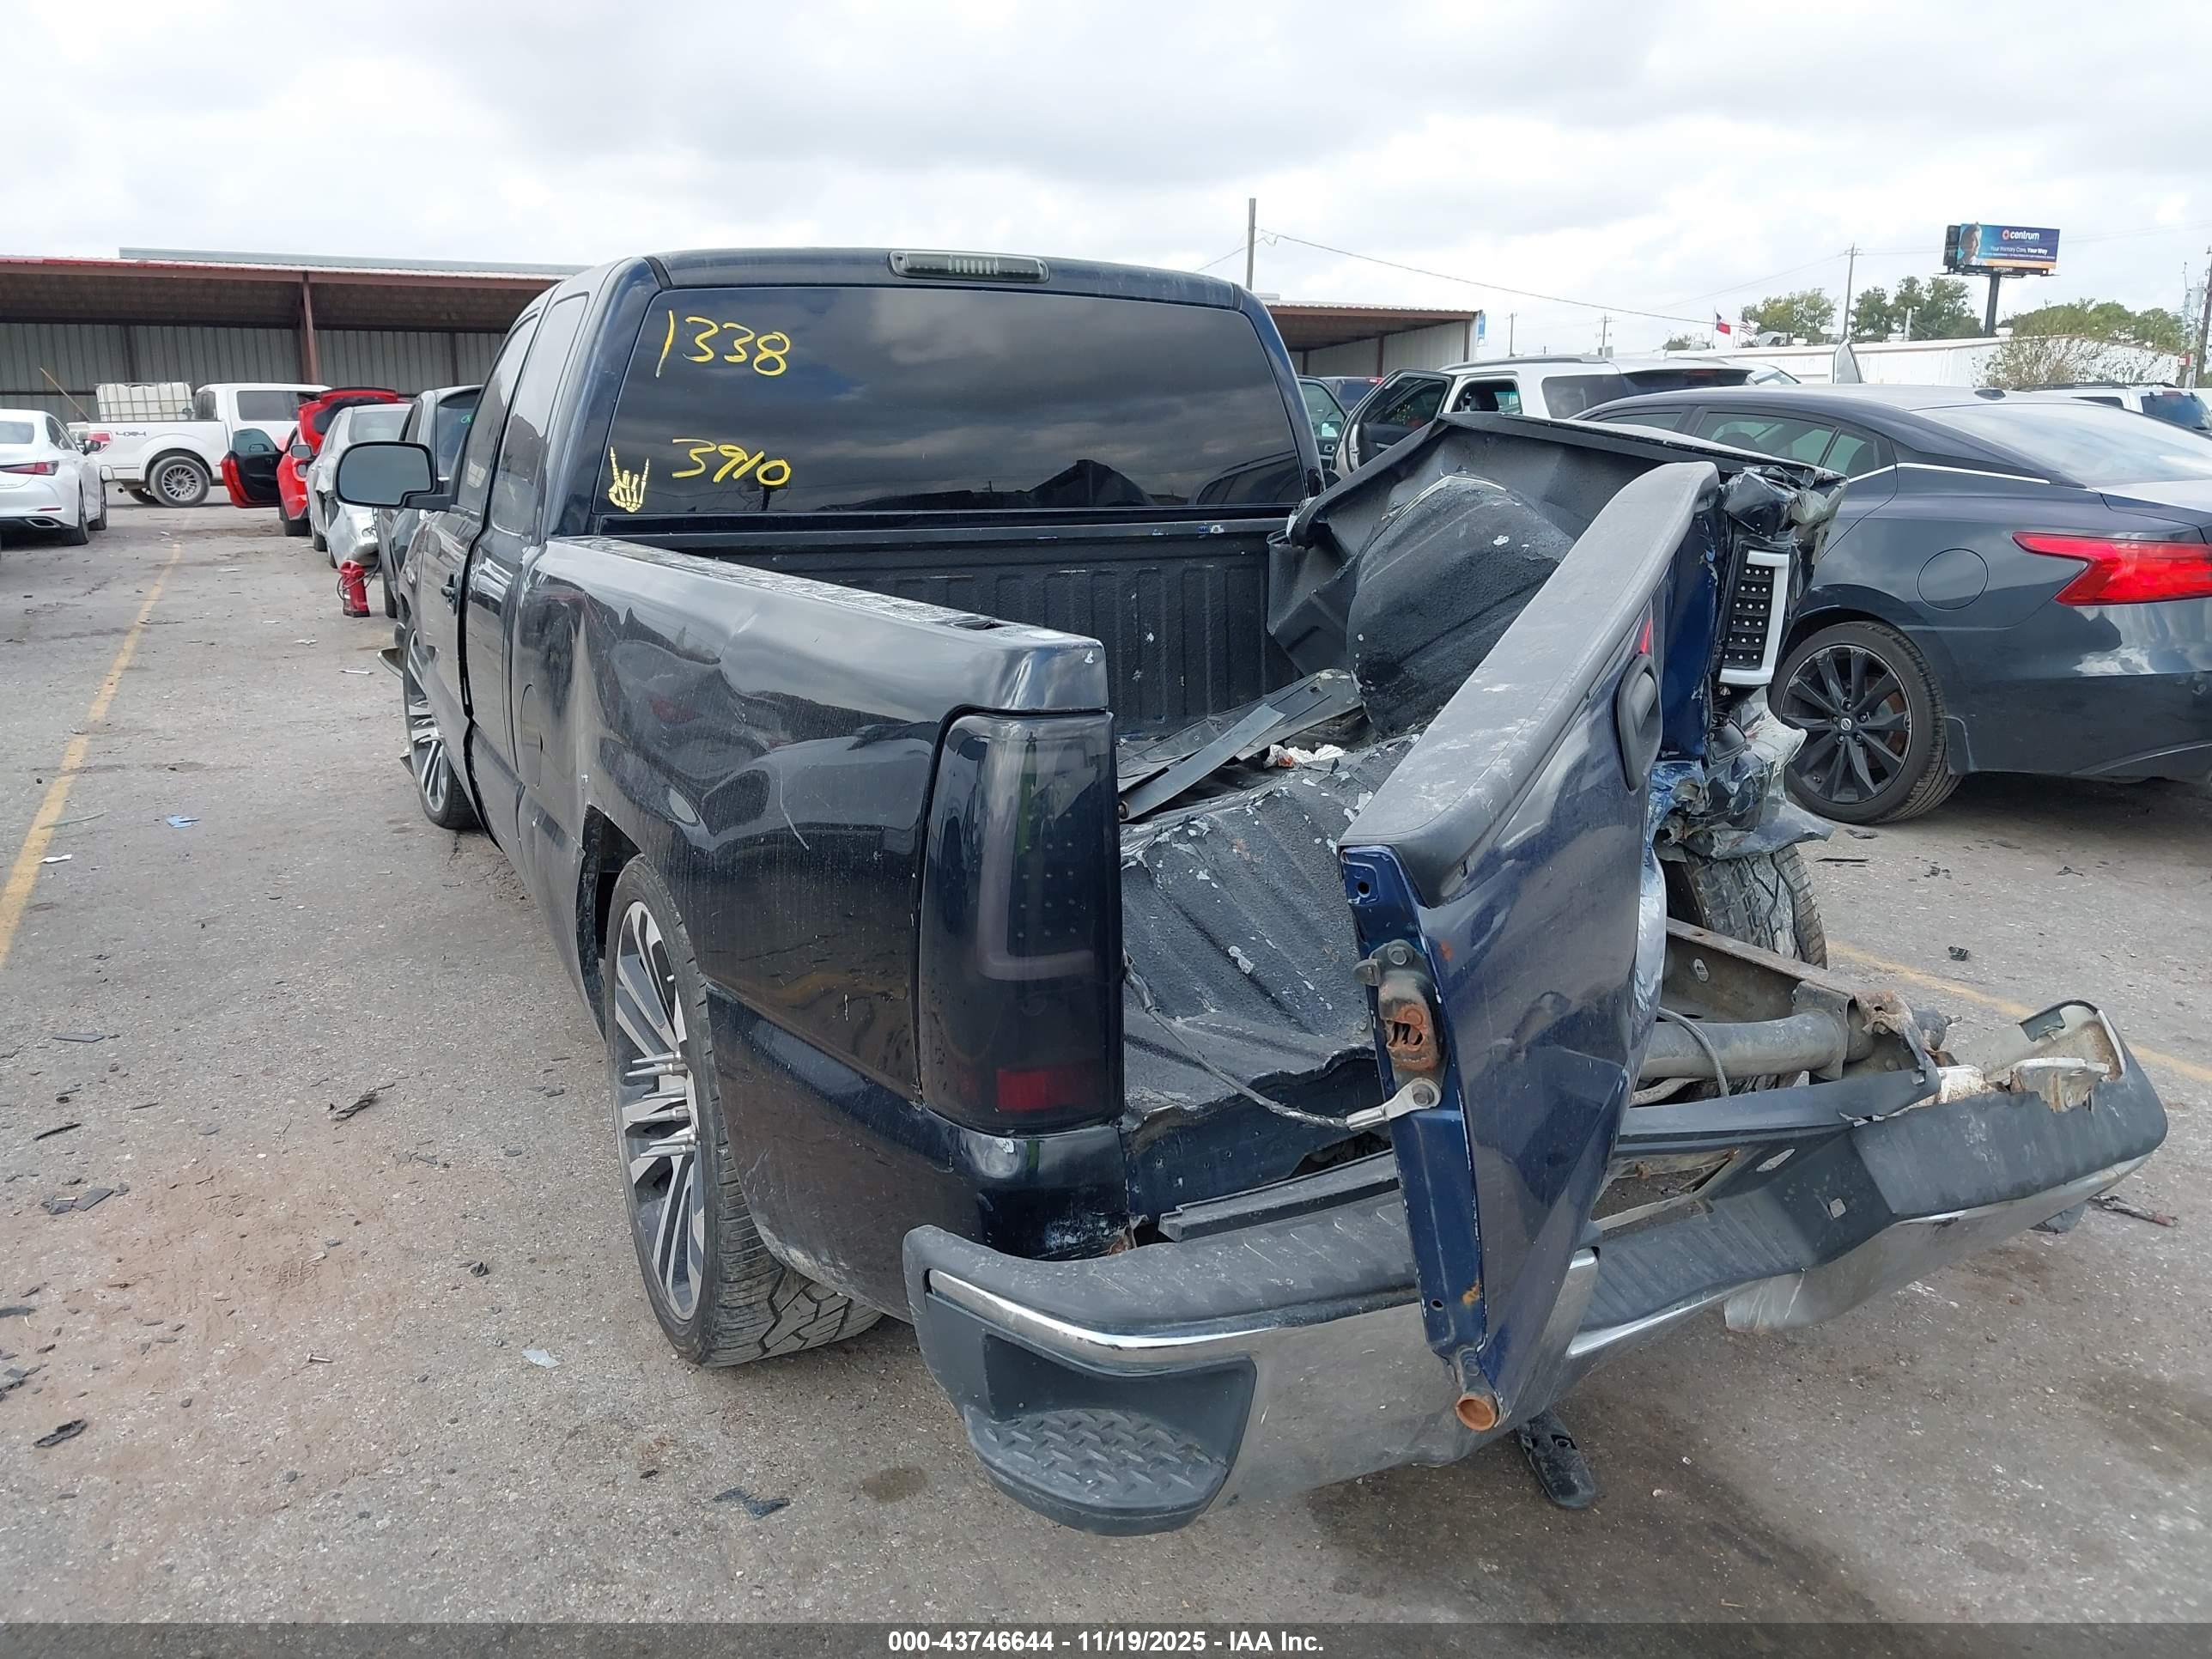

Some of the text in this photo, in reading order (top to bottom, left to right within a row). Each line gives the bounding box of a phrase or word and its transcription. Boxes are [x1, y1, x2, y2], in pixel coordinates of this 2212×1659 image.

[2009, 230, 2040, 240] centrum
[655, 310, 791, 378] 1338
[672, 438, 791, 483] 3910
